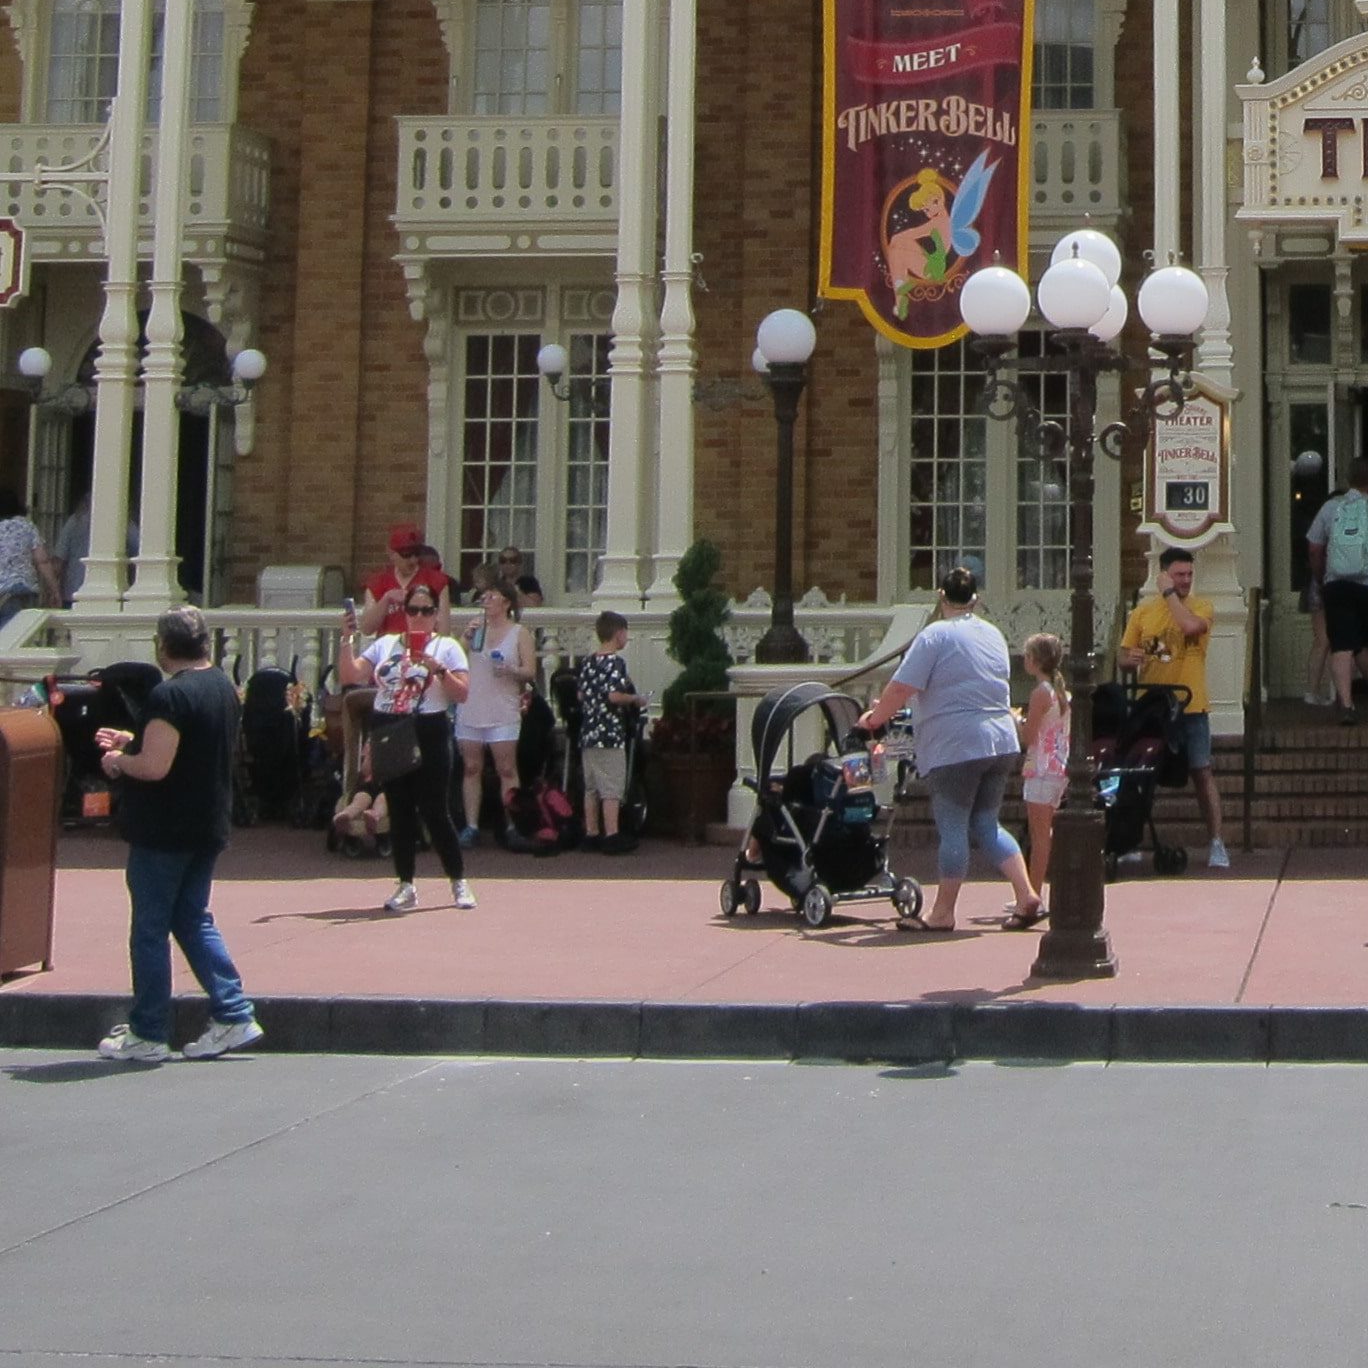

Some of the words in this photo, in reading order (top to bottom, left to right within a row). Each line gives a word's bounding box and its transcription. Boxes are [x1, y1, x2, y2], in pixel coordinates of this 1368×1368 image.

[892, 43, 962, 73] MEET
[837, 101, 940, 152] TINKER
[939, 95, 1016, 147] BELL
[1183, 487, 1205, 504] 30
